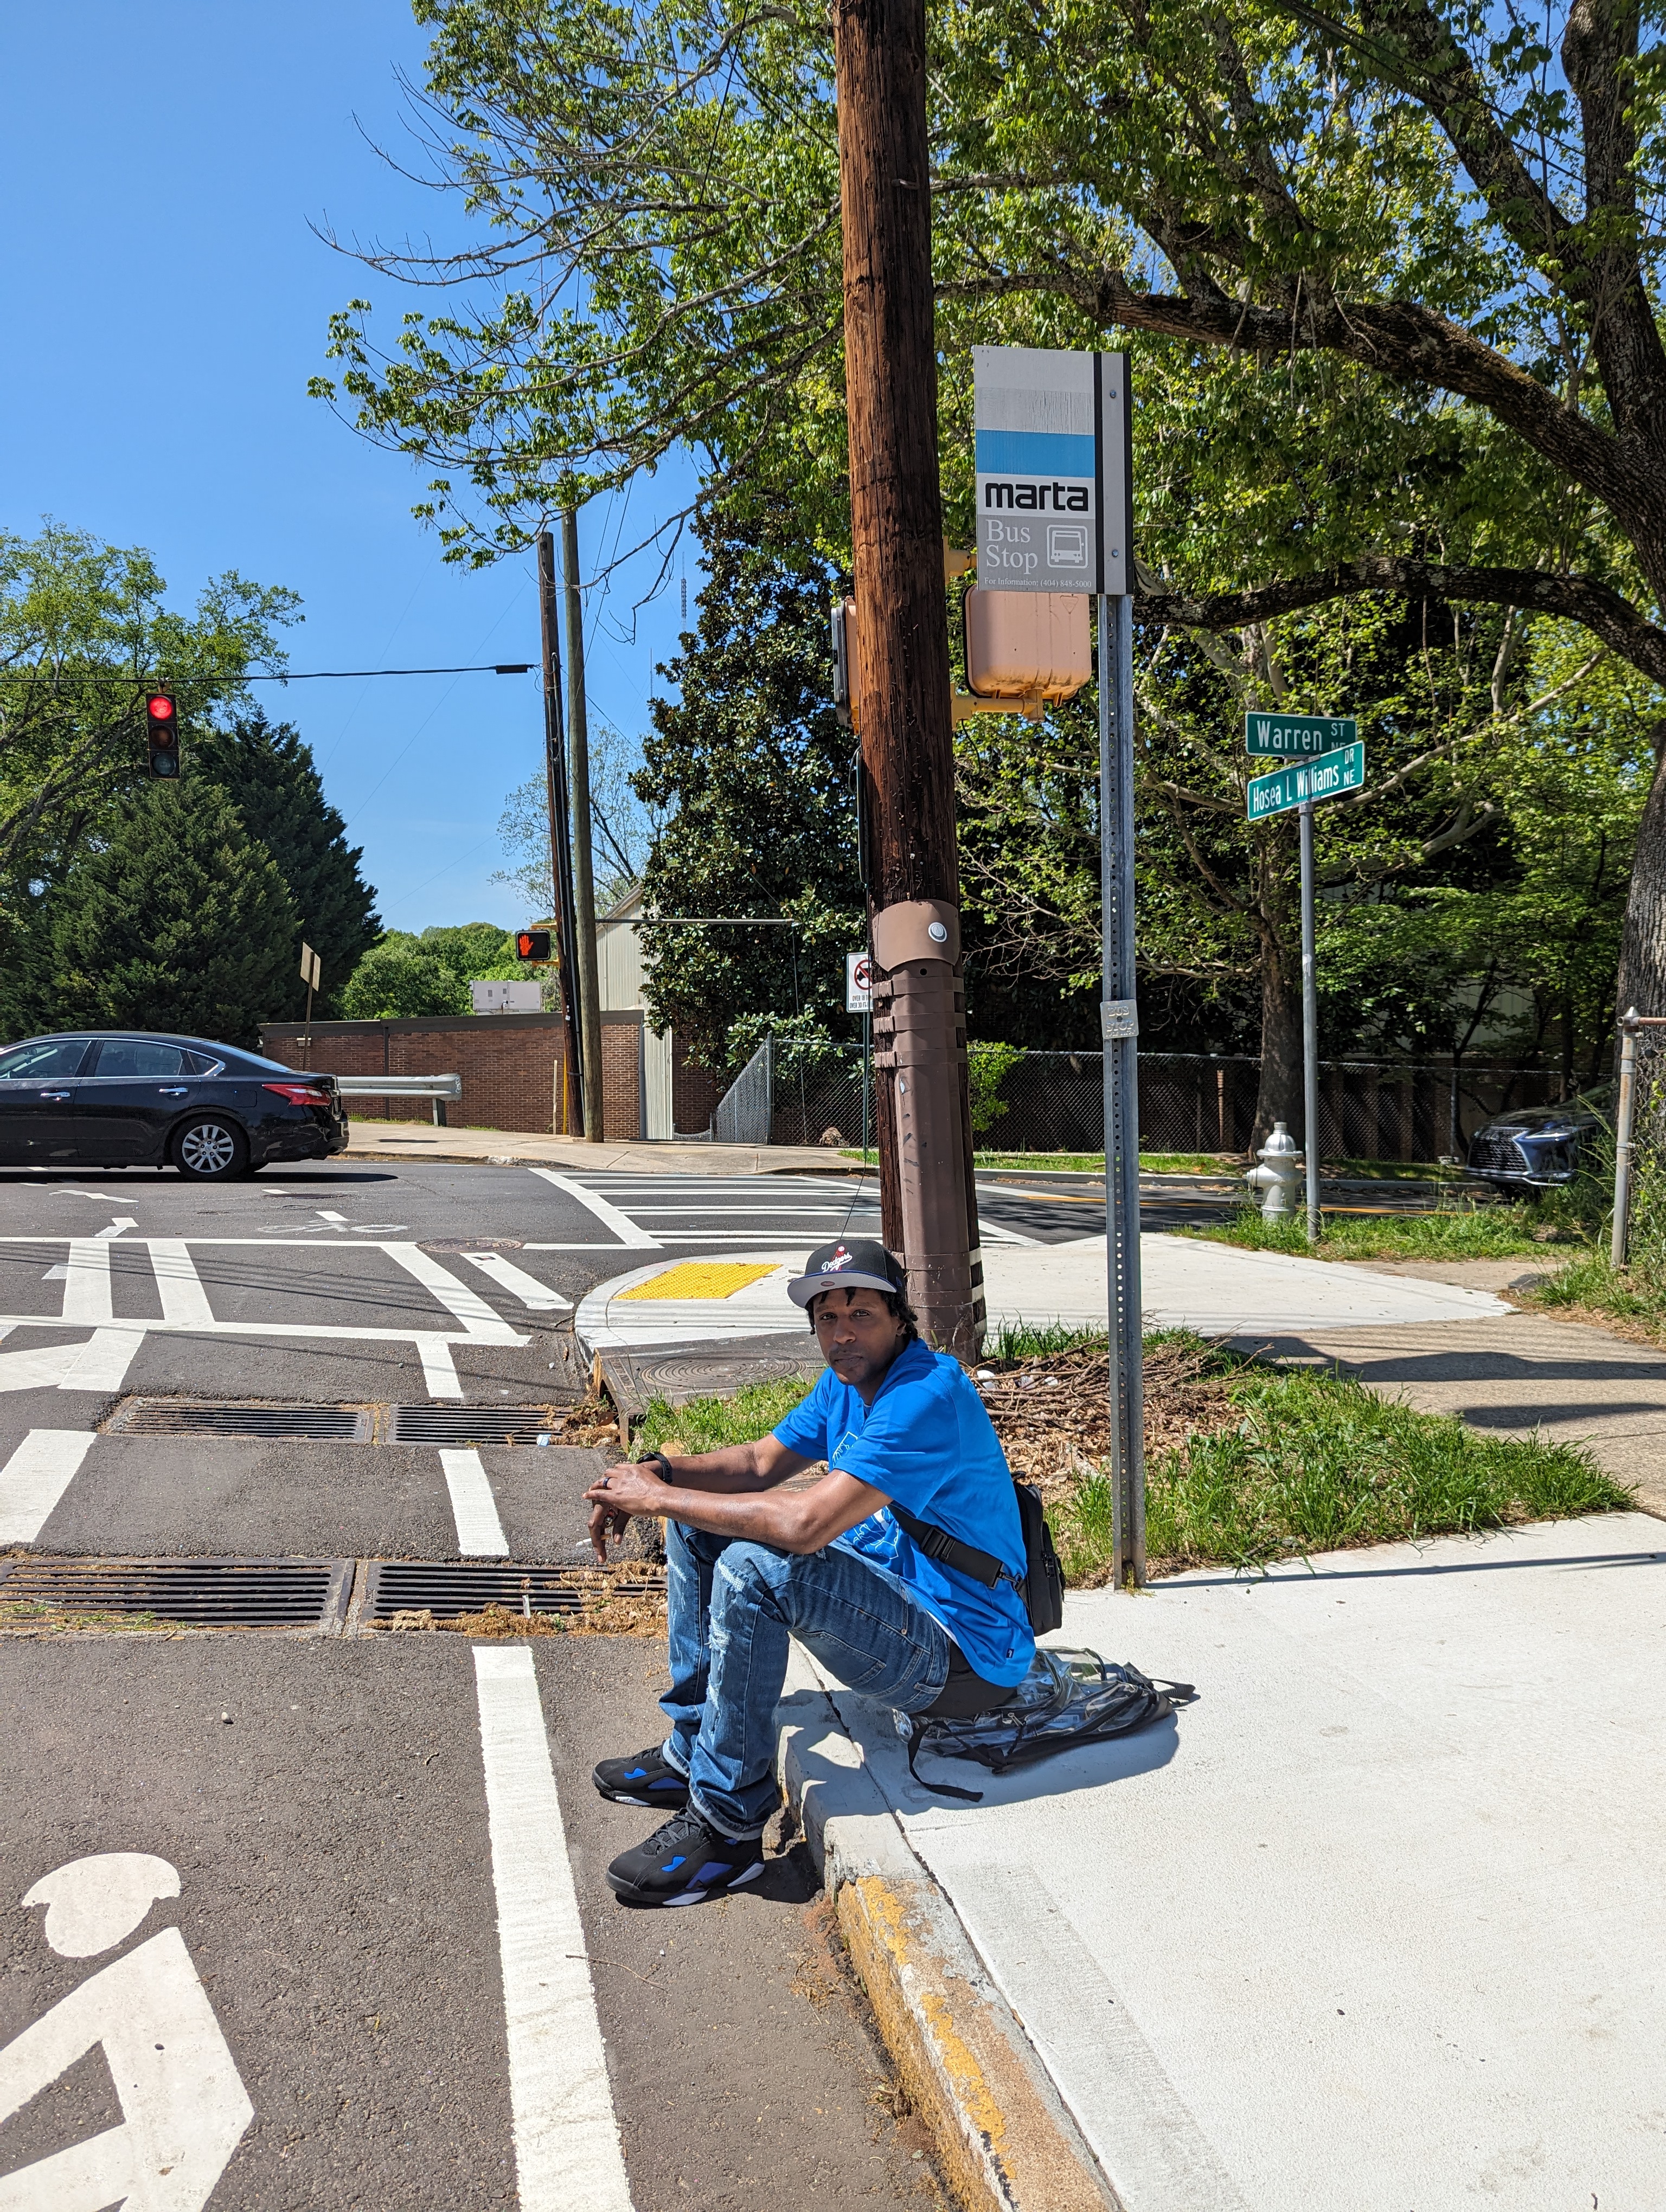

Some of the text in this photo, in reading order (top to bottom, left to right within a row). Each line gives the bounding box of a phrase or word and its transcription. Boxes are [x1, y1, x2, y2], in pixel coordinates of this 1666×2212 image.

[985, 481, 1088, 512] marta
[986, 519, 1030, 543] Bus
[986, 544, 1038, 575] Stop
[998, 577, 1039, 586] Information:
[1040, 578, 1059, 588] (404)
[1257, 720, 1345, 751] Warren ST
[1253, 748, 1354, 813] Hosea L Williams DR
[1343, 769, 1355, 787] NE
[1107, 1006, 1129, 1017] BUS
[1106, 1020, 1134, 1032] STOP
[821, 1252, 853, 1273] Dodgers
